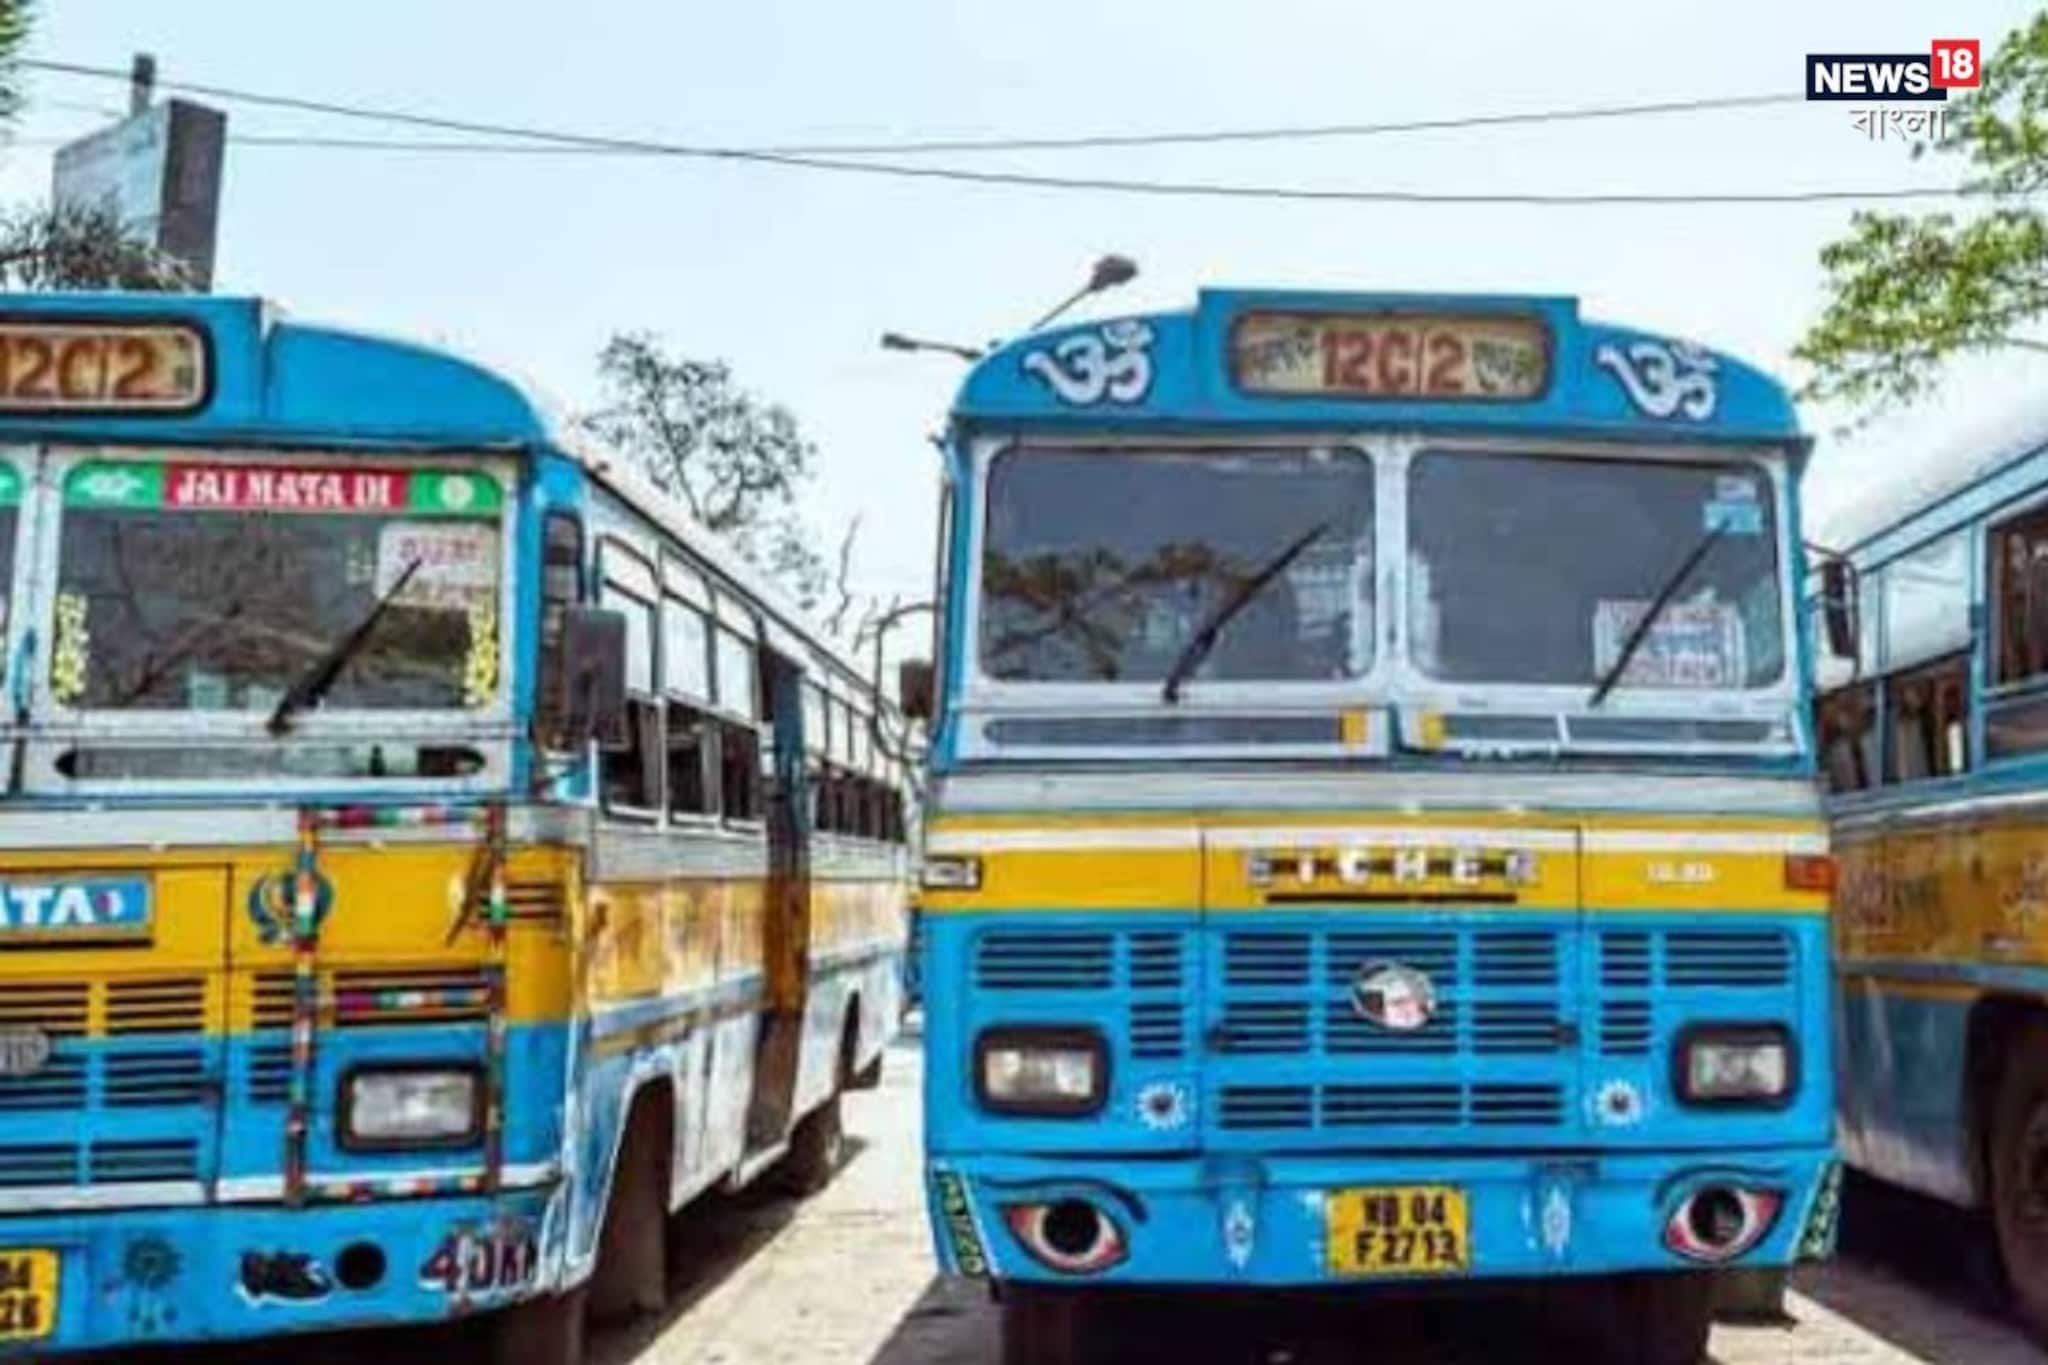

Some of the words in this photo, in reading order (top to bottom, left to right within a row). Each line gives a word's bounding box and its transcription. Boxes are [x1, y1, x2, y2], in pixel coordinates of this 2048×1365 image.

[177, 468, 237, 506] JAI
[247, 469, 345, 507] MATA
[353, 472, 392, 506] DI
[0, 885, 96, 925] TA
[1411, 1192, 1445, 1226] 04
